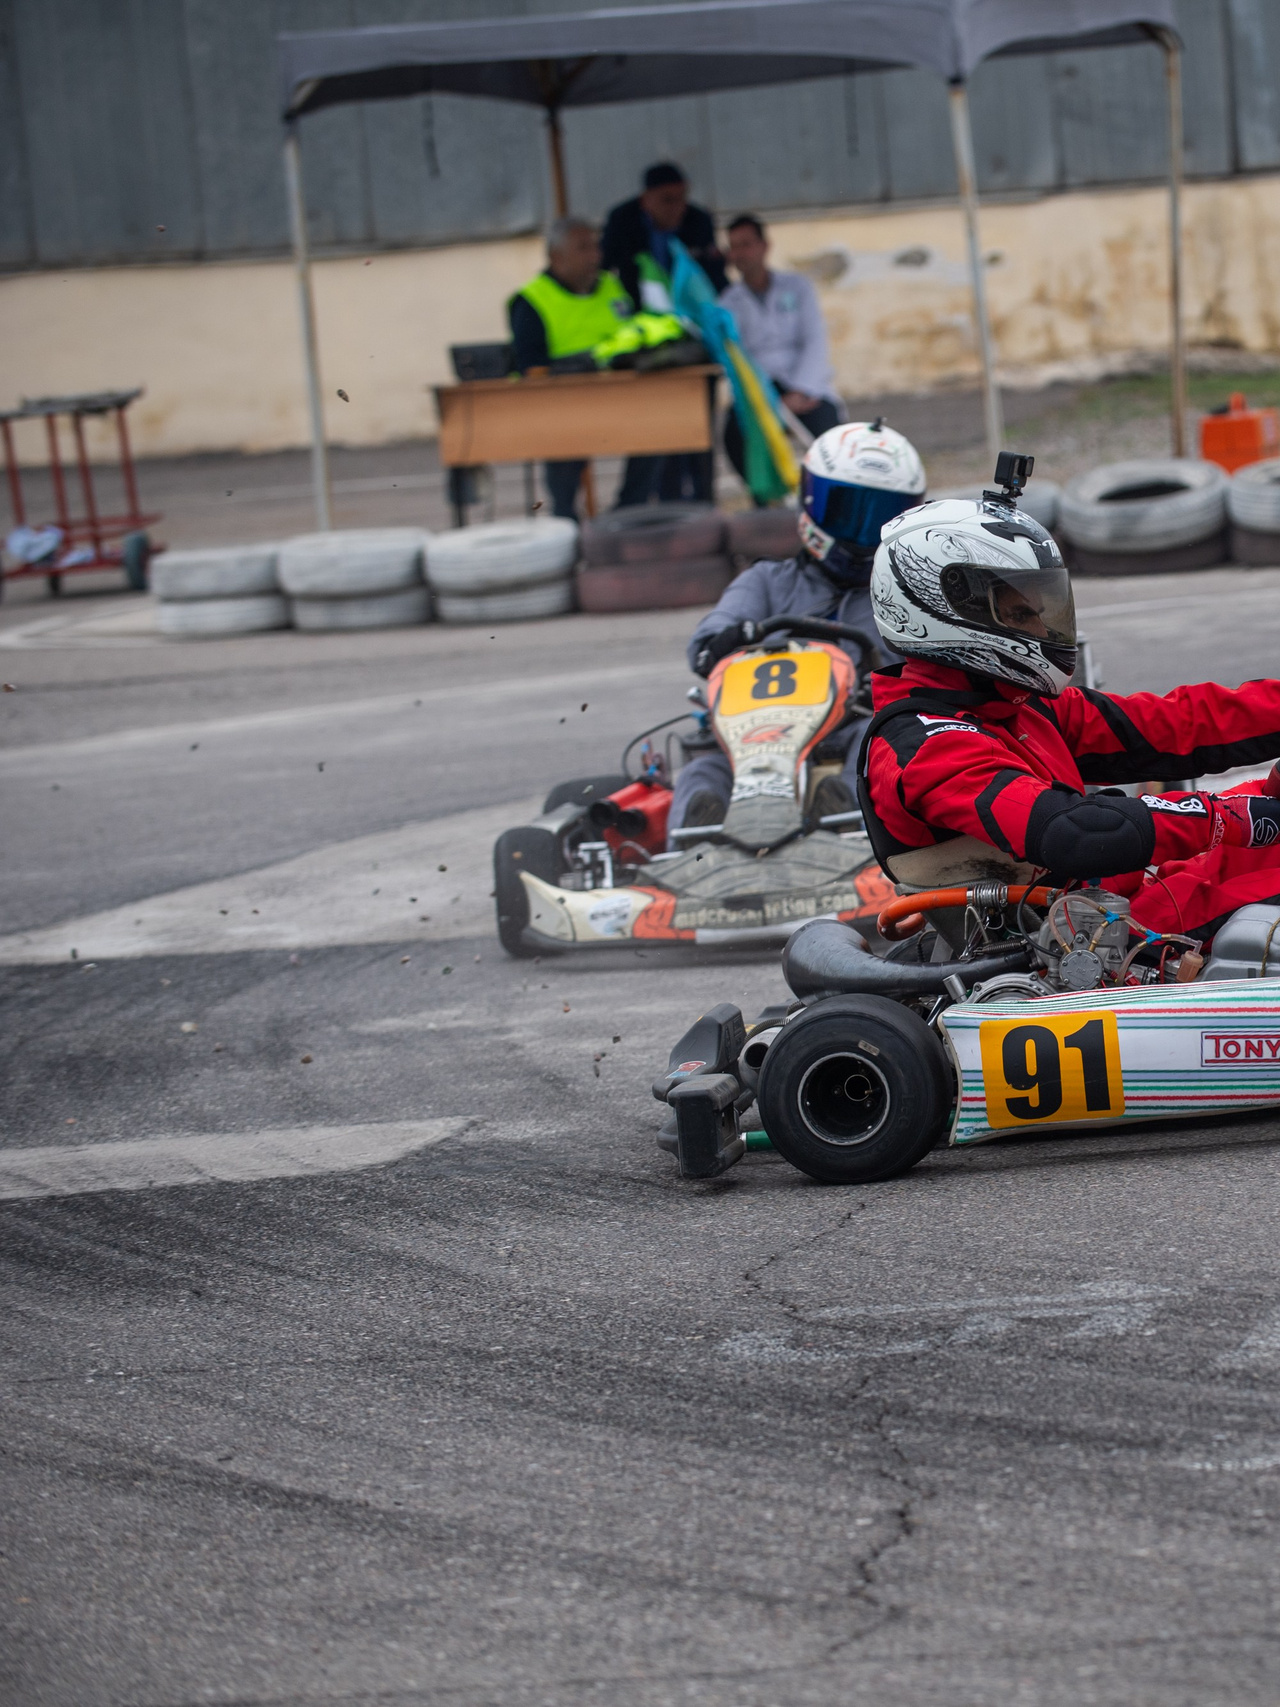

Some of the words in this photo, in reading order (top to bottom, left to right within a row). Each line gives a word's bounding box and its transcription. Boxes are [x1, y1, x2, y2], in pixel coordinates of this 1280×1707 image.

[752, 659, 797, 699] 8
[1141, 794, 1206, 813] sparco
[1002, 1019, 1111, 1120] 91
